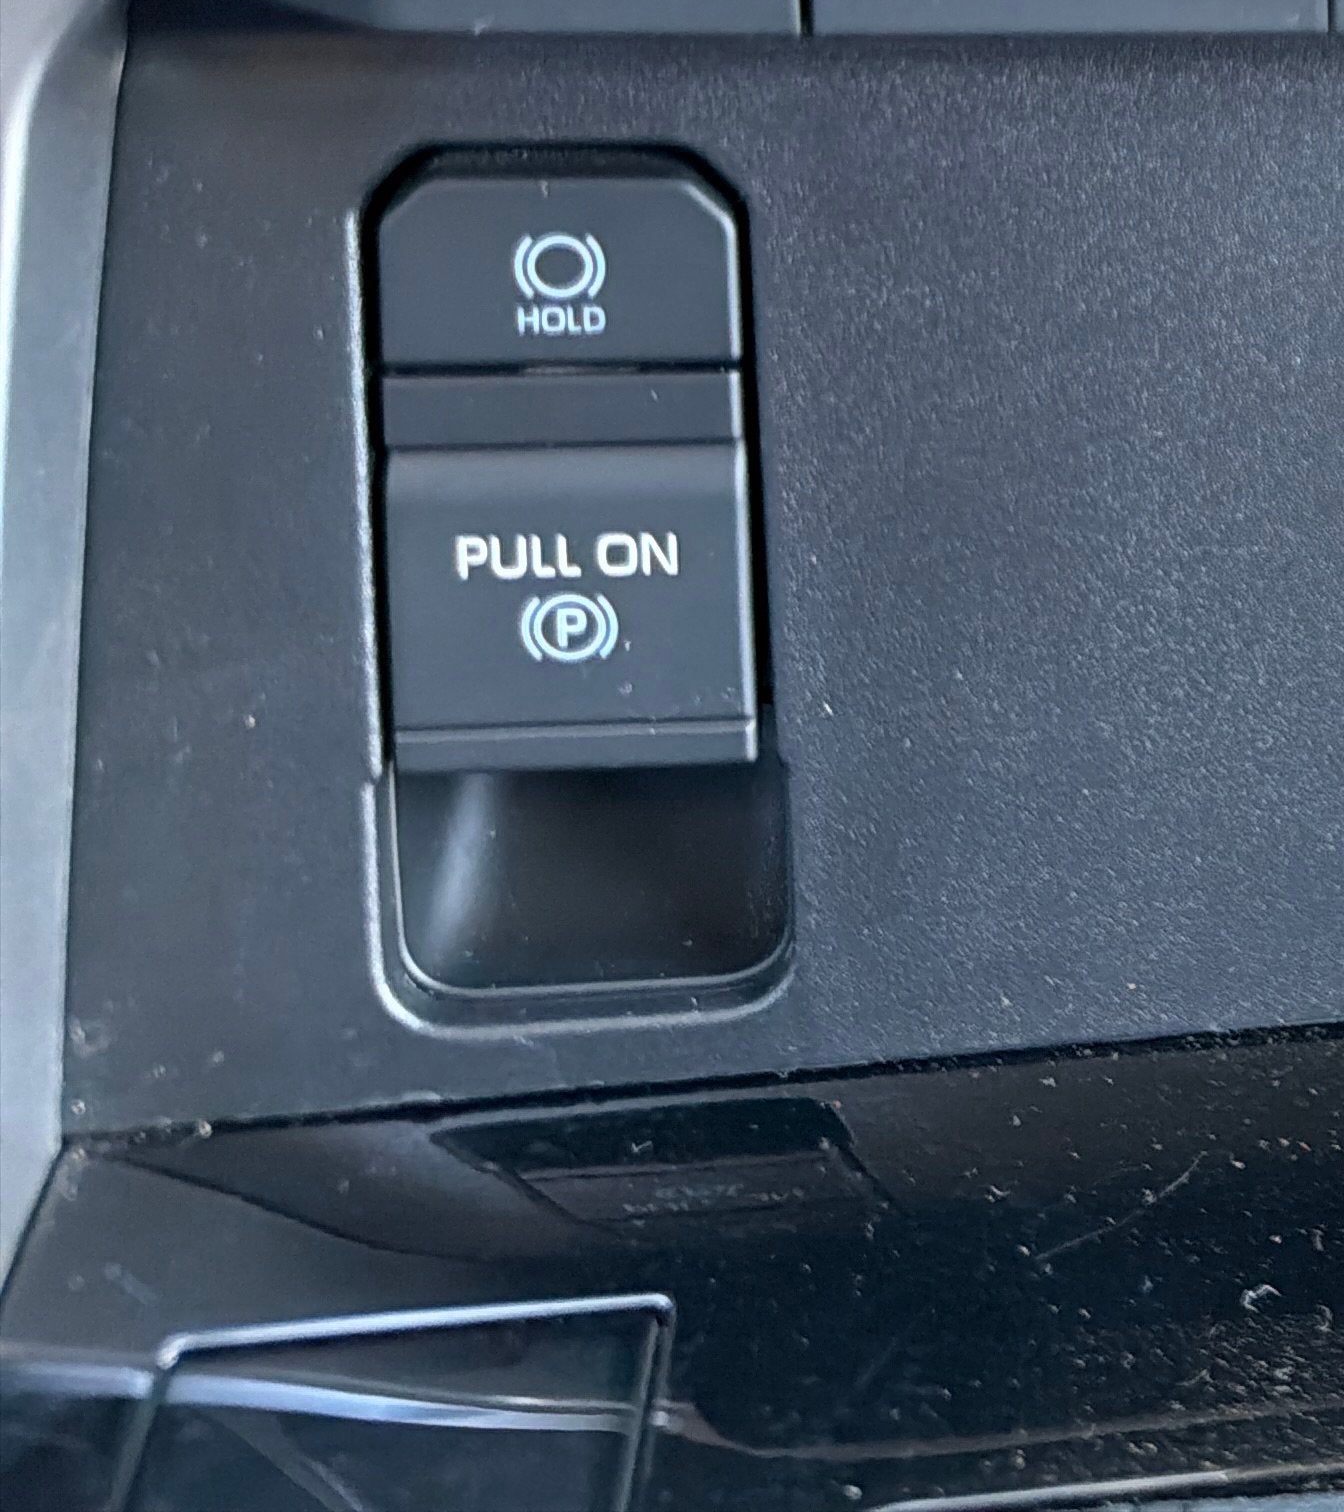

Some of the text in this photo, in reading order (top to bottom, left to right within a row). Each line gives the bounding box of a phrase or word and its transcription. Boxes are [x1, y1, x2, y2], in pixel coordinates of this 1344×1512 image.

[516, 303, 606, 335] HOLD
[454, 531, 679, 580] PULL ON
[556, 607, 588, 648] P
